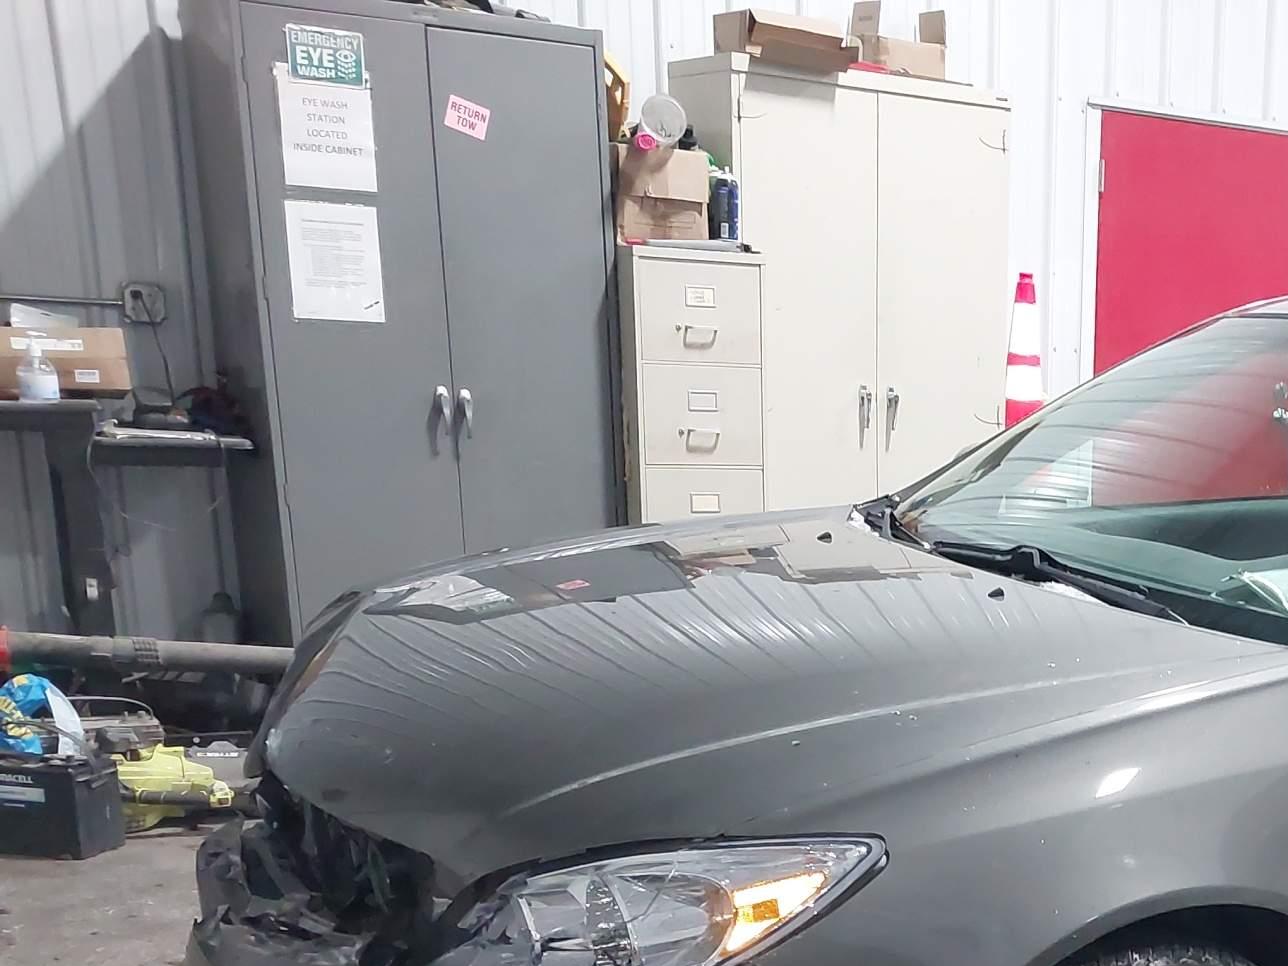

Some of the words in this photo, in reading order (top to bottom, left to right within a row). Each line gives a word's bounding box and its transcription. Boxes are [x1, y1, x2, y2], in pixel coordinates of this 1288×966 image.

[291, 31, 360, 50] EMERGENCY
[295, 45, 336, 68] EYE
[297, 65, 336, 79] WASH
[302, 97, 319, 107] EYE
[320, 99, 348, 110] WASH
[306, 113, 346, 124] STATION
[450, 101, 487, 124] RETURN
[457, 115, 477, 131] TOW
[306, 129, 348, 140] LOCATED
[293, 143, 324, 153] INSIDE
[325, 145, 363, 156] CABINET
